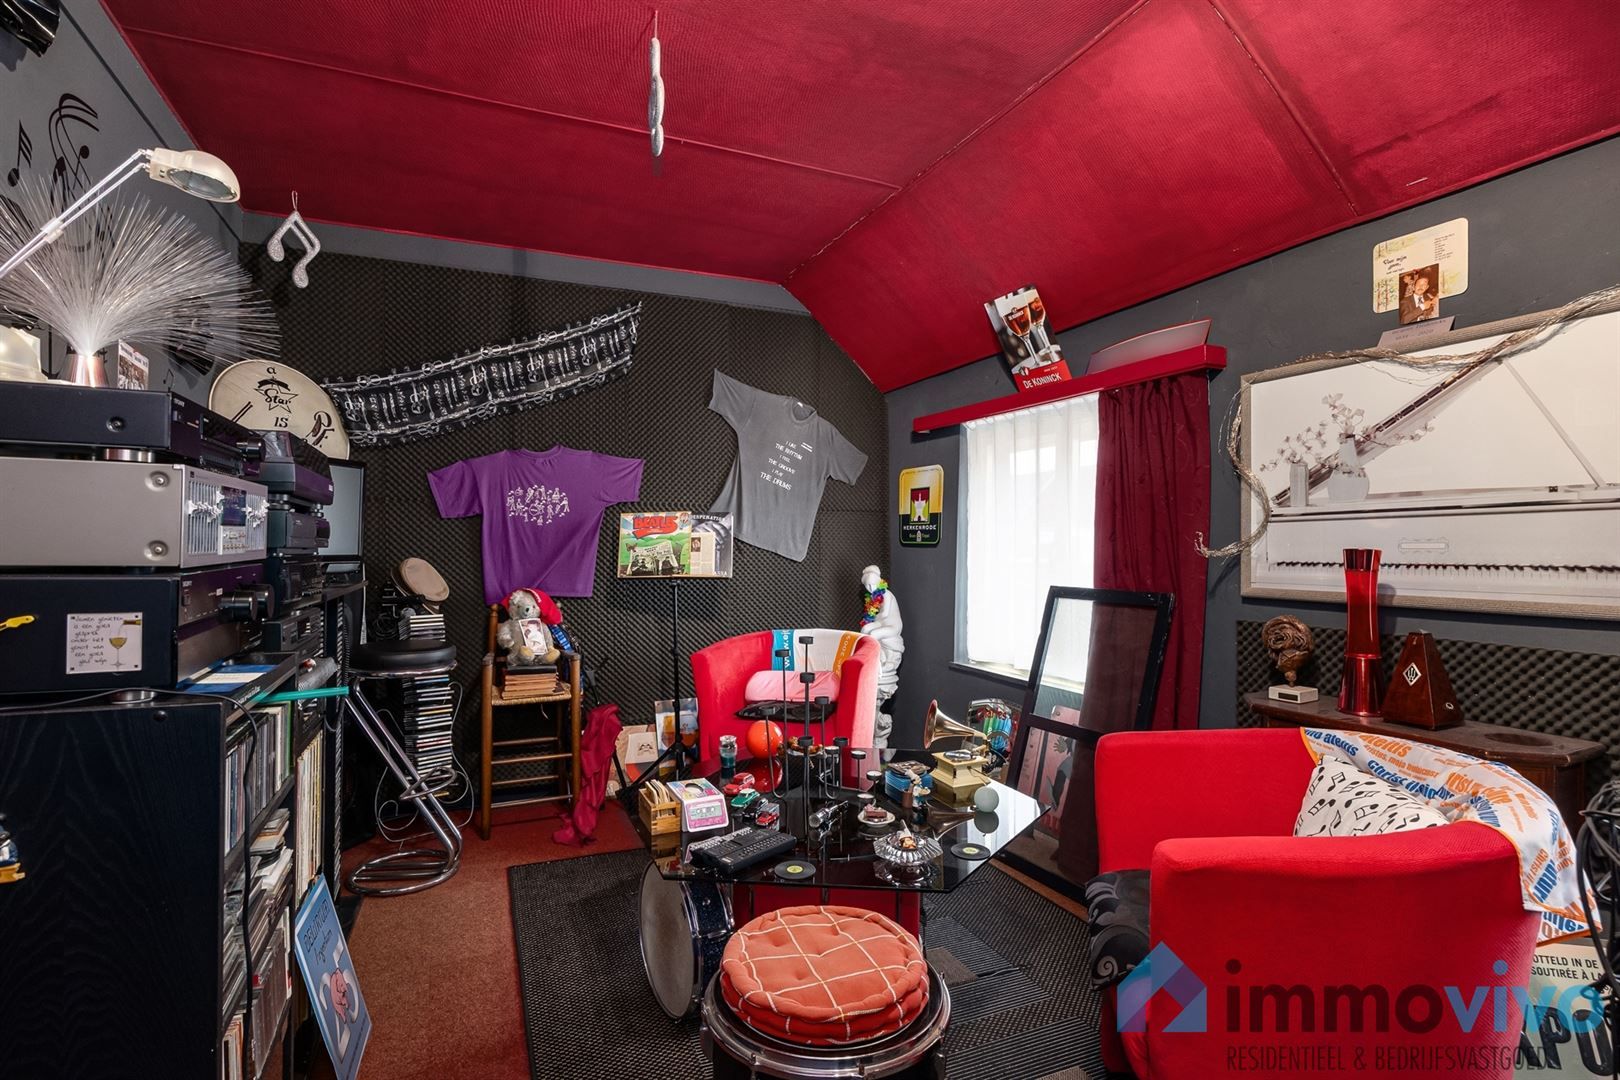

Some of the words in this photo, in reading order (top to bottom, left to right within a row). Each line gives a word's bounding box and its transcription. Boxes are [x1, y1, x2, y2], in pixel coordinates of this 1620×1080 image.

[1022, 379, 1033, 389] DE
[1031, 372, 1062, 387] KONINCK
[264, 388, 292, 405] Star
[768, 457, 778, 466] THE
[760, 471, 772, 482] THE
[772, 477, 792, 491] DRUMS
[1571, 958, 1582, 968] IN
[1585, 959, 1598, 969] DE
[1531, 966, 1579, 980] SOUTIRÉE
[1582, 969, 1589, 980] À
